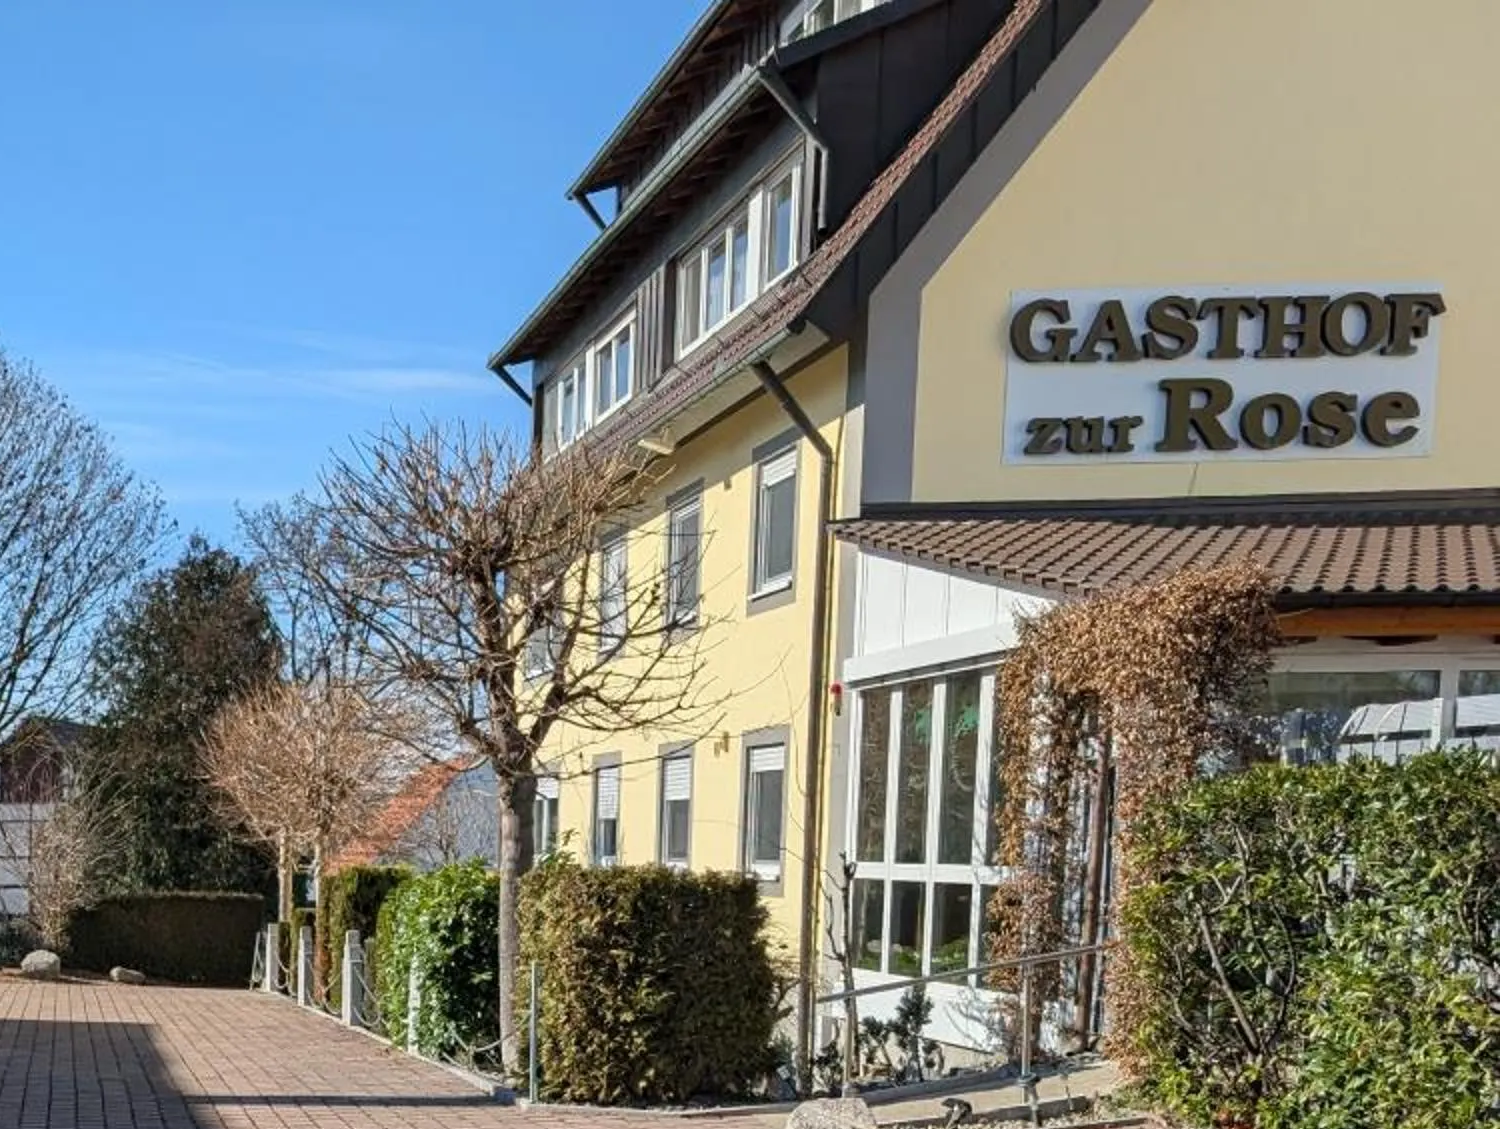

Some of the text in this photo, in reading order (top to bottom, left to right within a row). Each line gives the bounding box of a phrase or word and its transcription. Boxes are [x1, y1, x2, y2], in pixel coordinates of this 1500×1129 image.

[1009, 292, 1447, 362] GASTHOF
[1023, 378, 1421, 455] zur Rose
